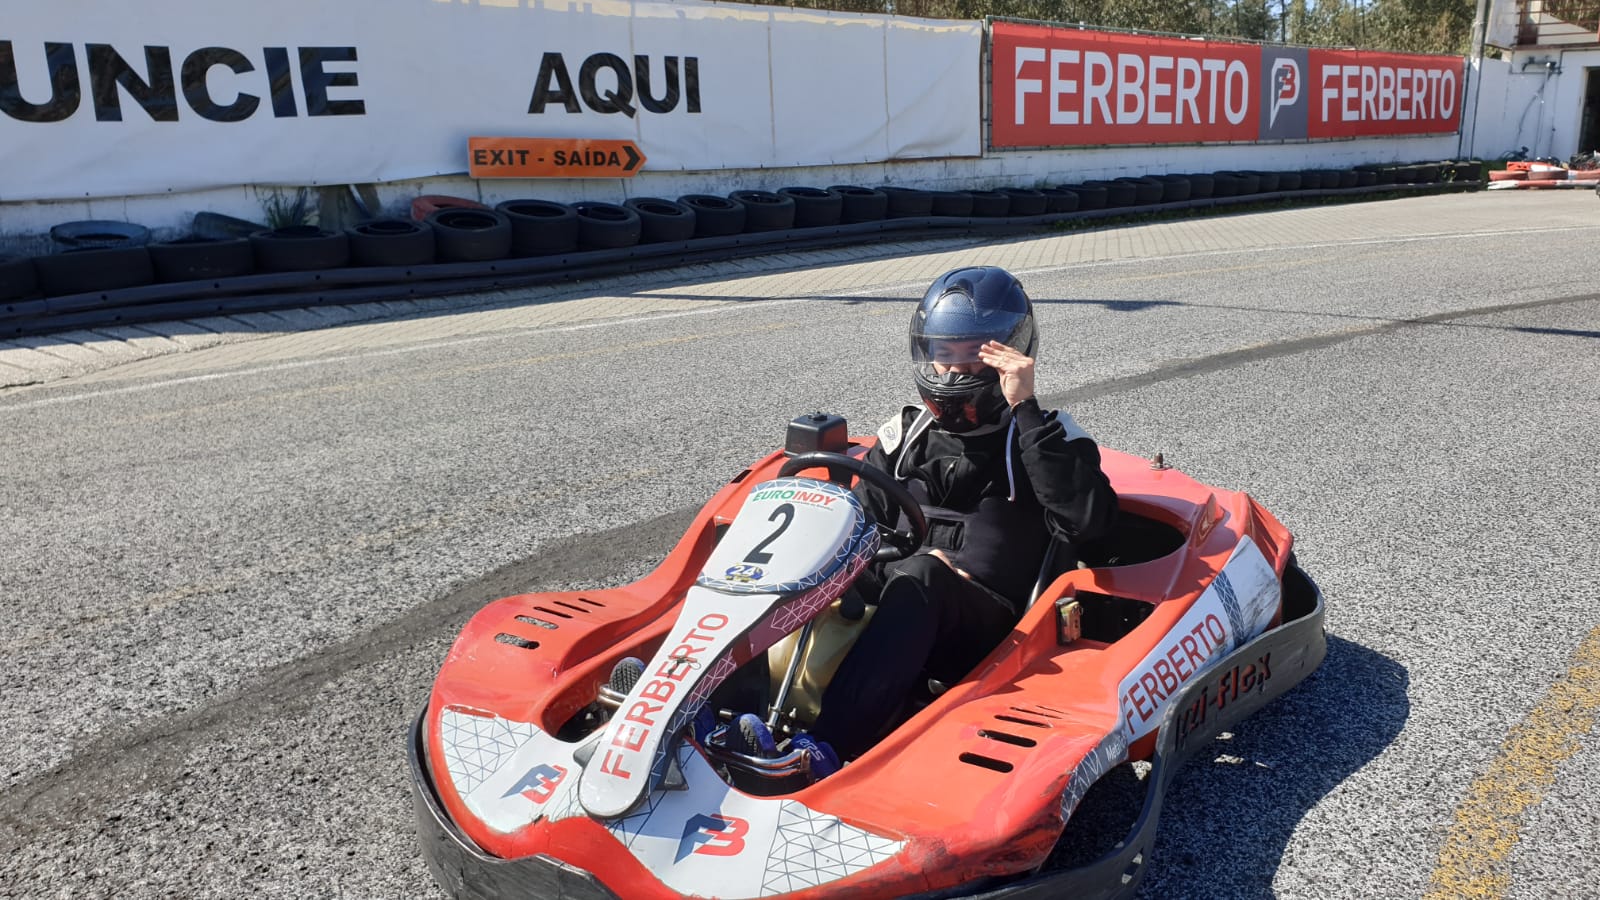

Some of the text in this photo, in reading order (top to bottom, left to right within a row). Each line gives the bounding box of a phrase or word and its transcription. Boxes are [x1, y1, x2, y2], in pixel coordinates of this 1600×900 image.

[0, 40, 701, 123] UNCIE AQUI
[1015, 46, 1249, 125] FERBERTO
[1322, 65, 1456, 122] FERBERTO
[474, 150, 530, 166] EXIT
[553, 147, 621, 166] SAÍDA
[753, 490, 837, 506] EUROINDY
[742, 503, 796, 565] 2
[600, 613, 729, 779] FERBERTO
[1121, 613, 1226, 735] FERBERTO
